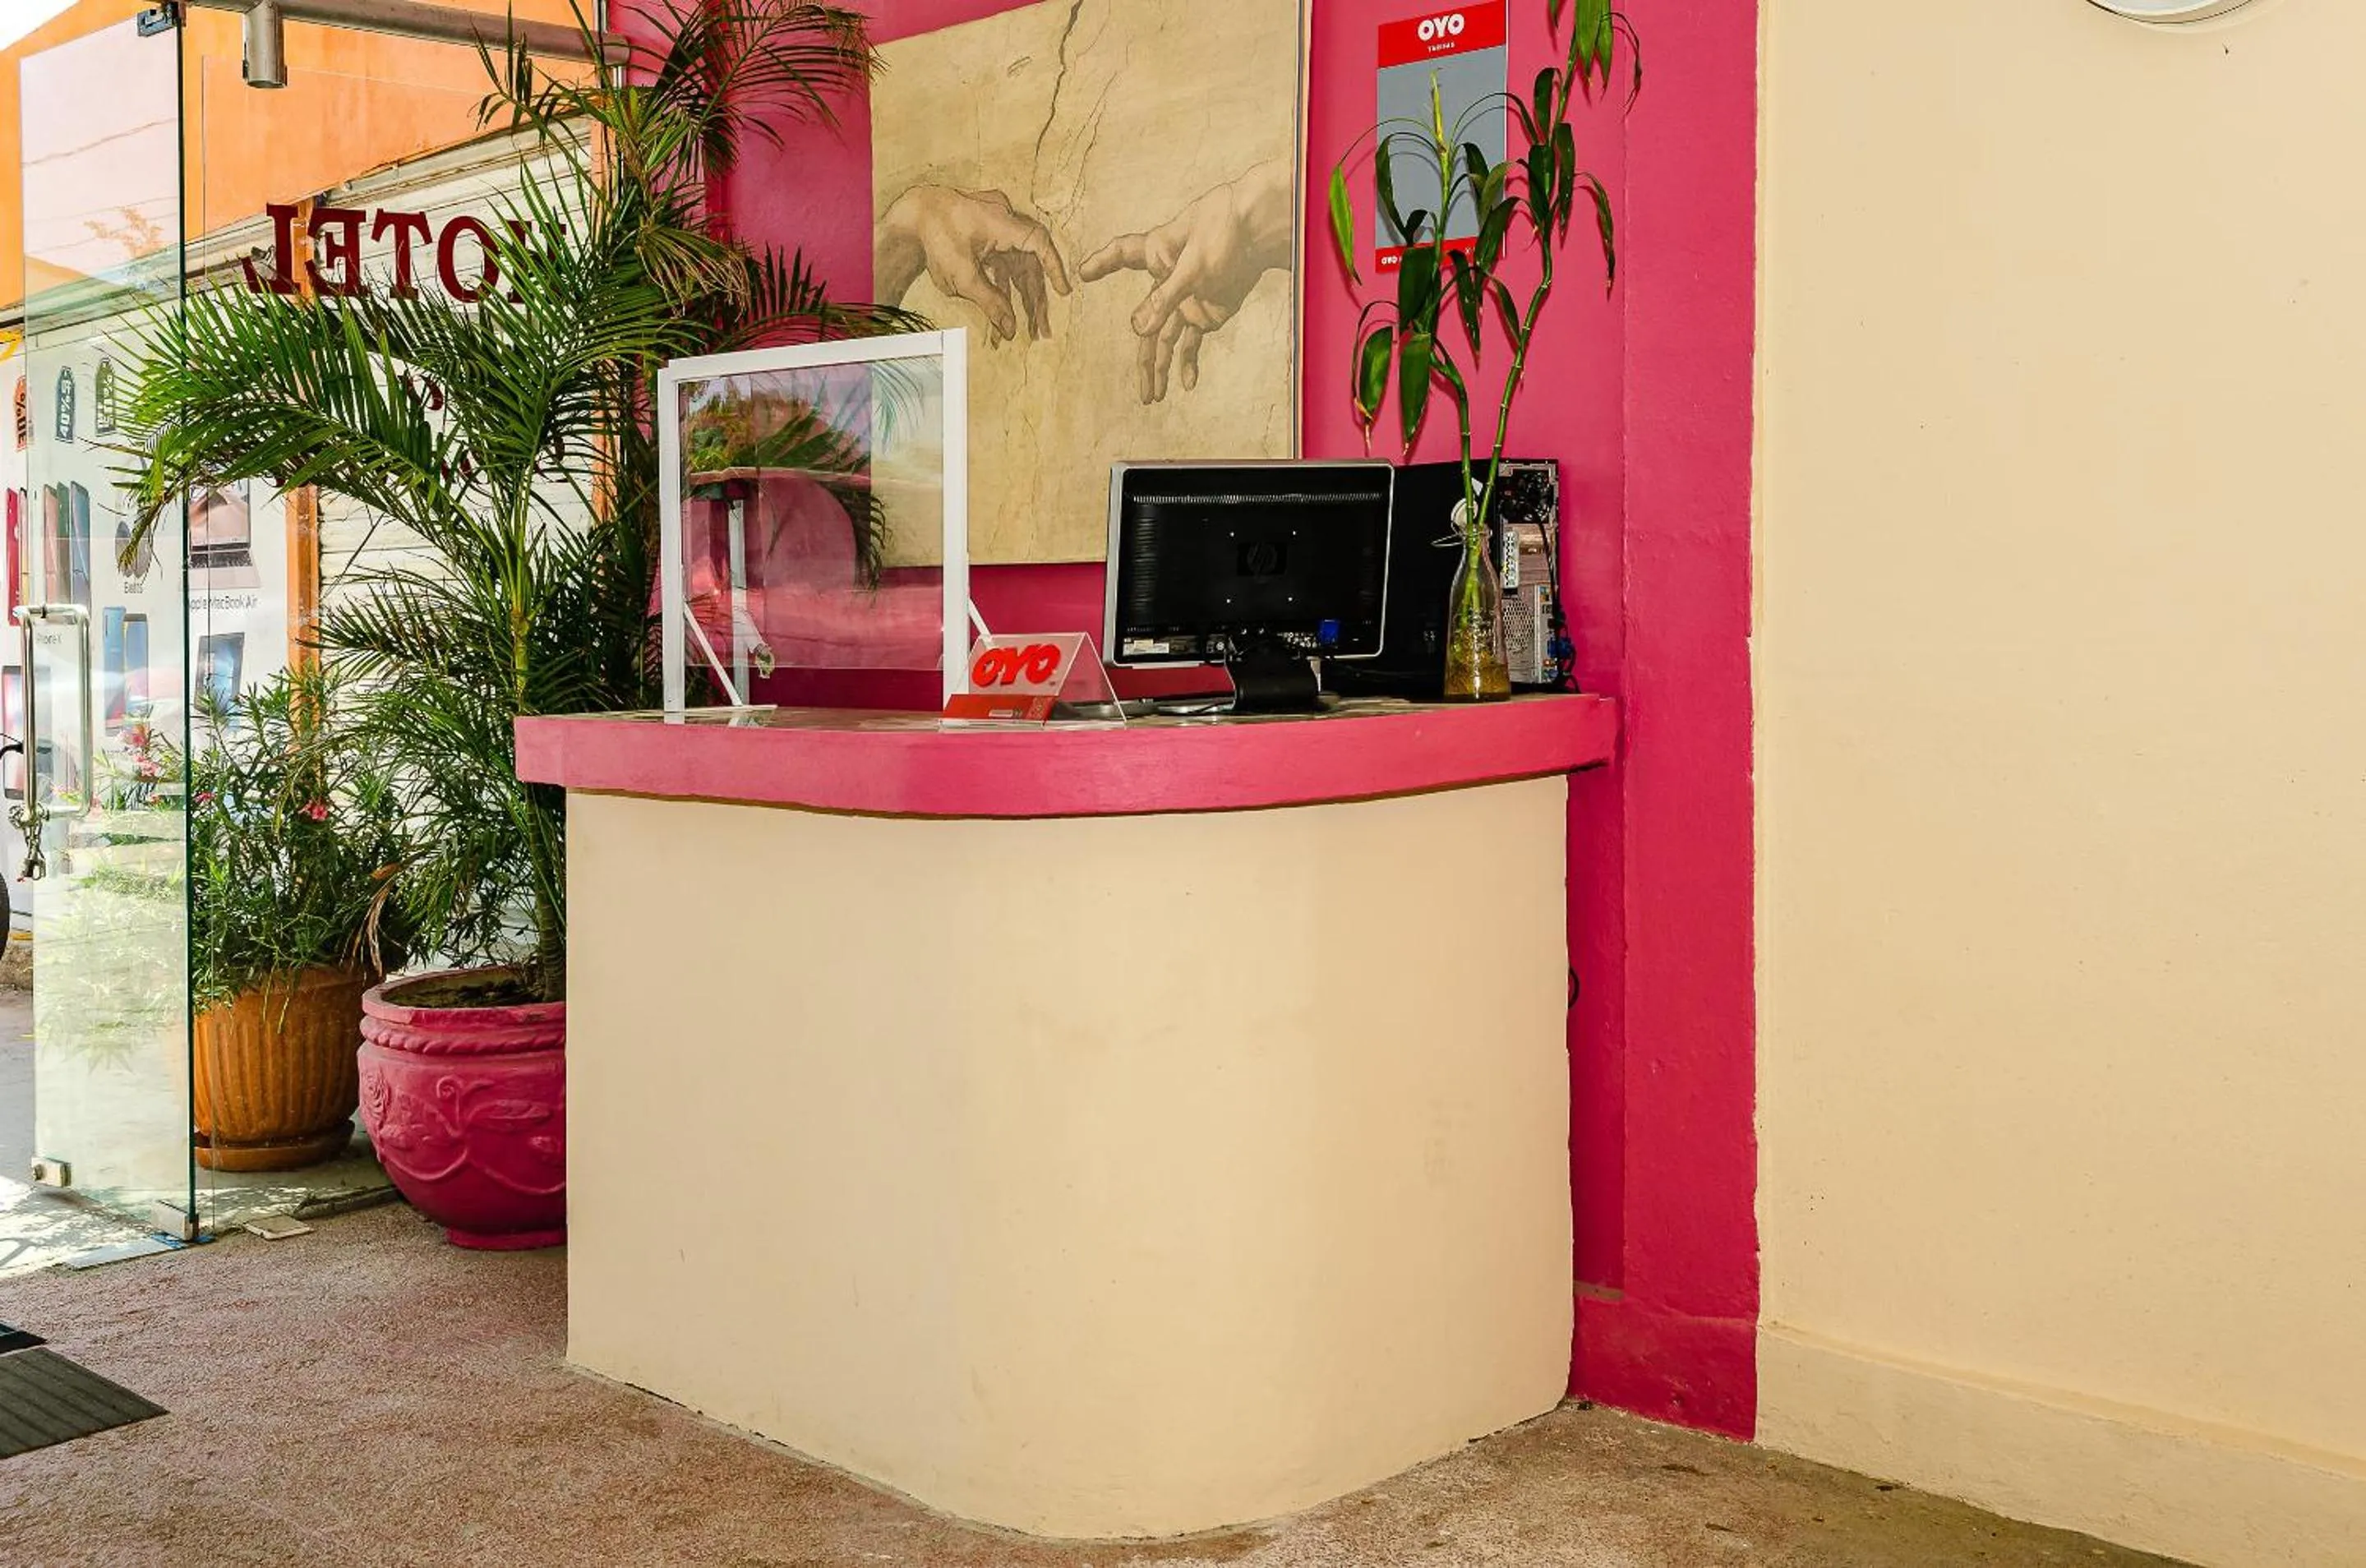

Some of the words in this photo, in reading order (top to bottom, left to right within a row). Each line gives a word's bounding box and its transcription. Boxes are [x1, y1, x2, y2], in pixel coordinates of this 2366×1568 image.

[1418, 13, 1464, 41] OYO
[188, 597, 208, 613] pple
[971, 643, 1062, 688] OYO
